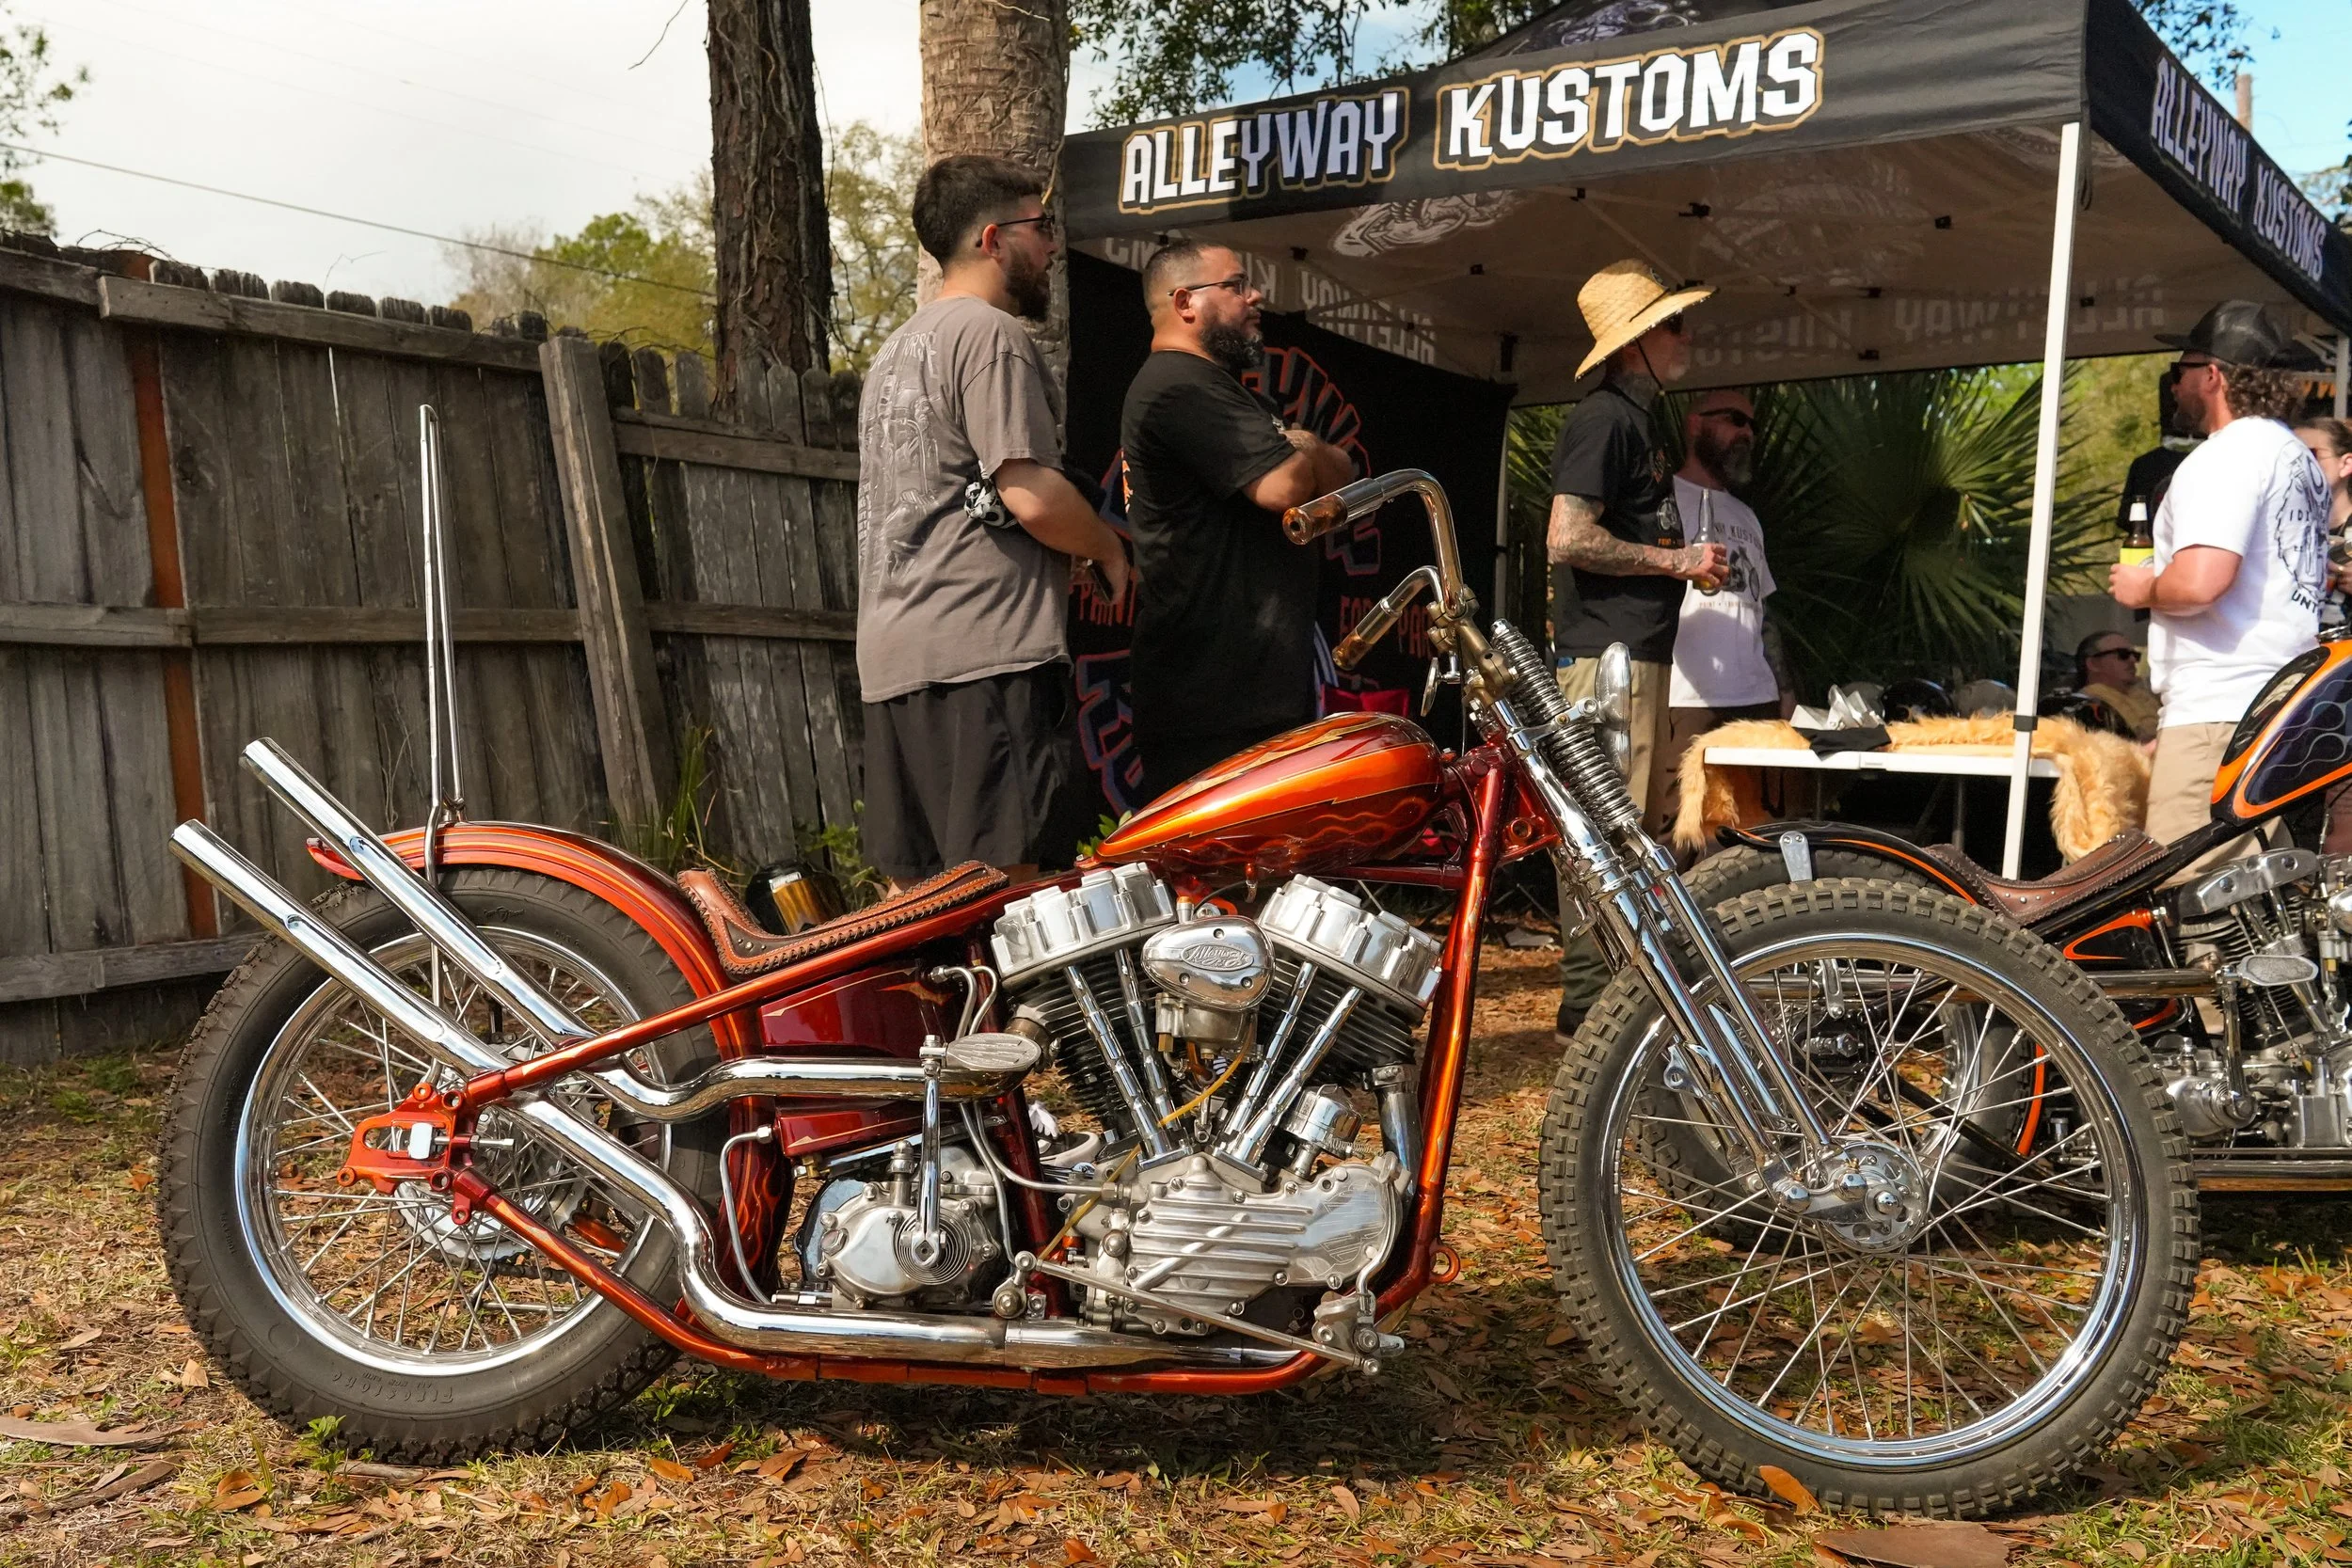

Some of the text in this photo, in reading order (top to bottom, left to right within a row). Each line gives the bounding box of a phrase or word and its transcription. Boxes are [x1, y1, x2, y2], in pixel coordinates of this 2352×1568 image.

[1120, 31, 1821, 207] ALLEYWAY KUSTOMS
[2151, 56, 2327, 283] ALLEYWAY KUSTOMS
